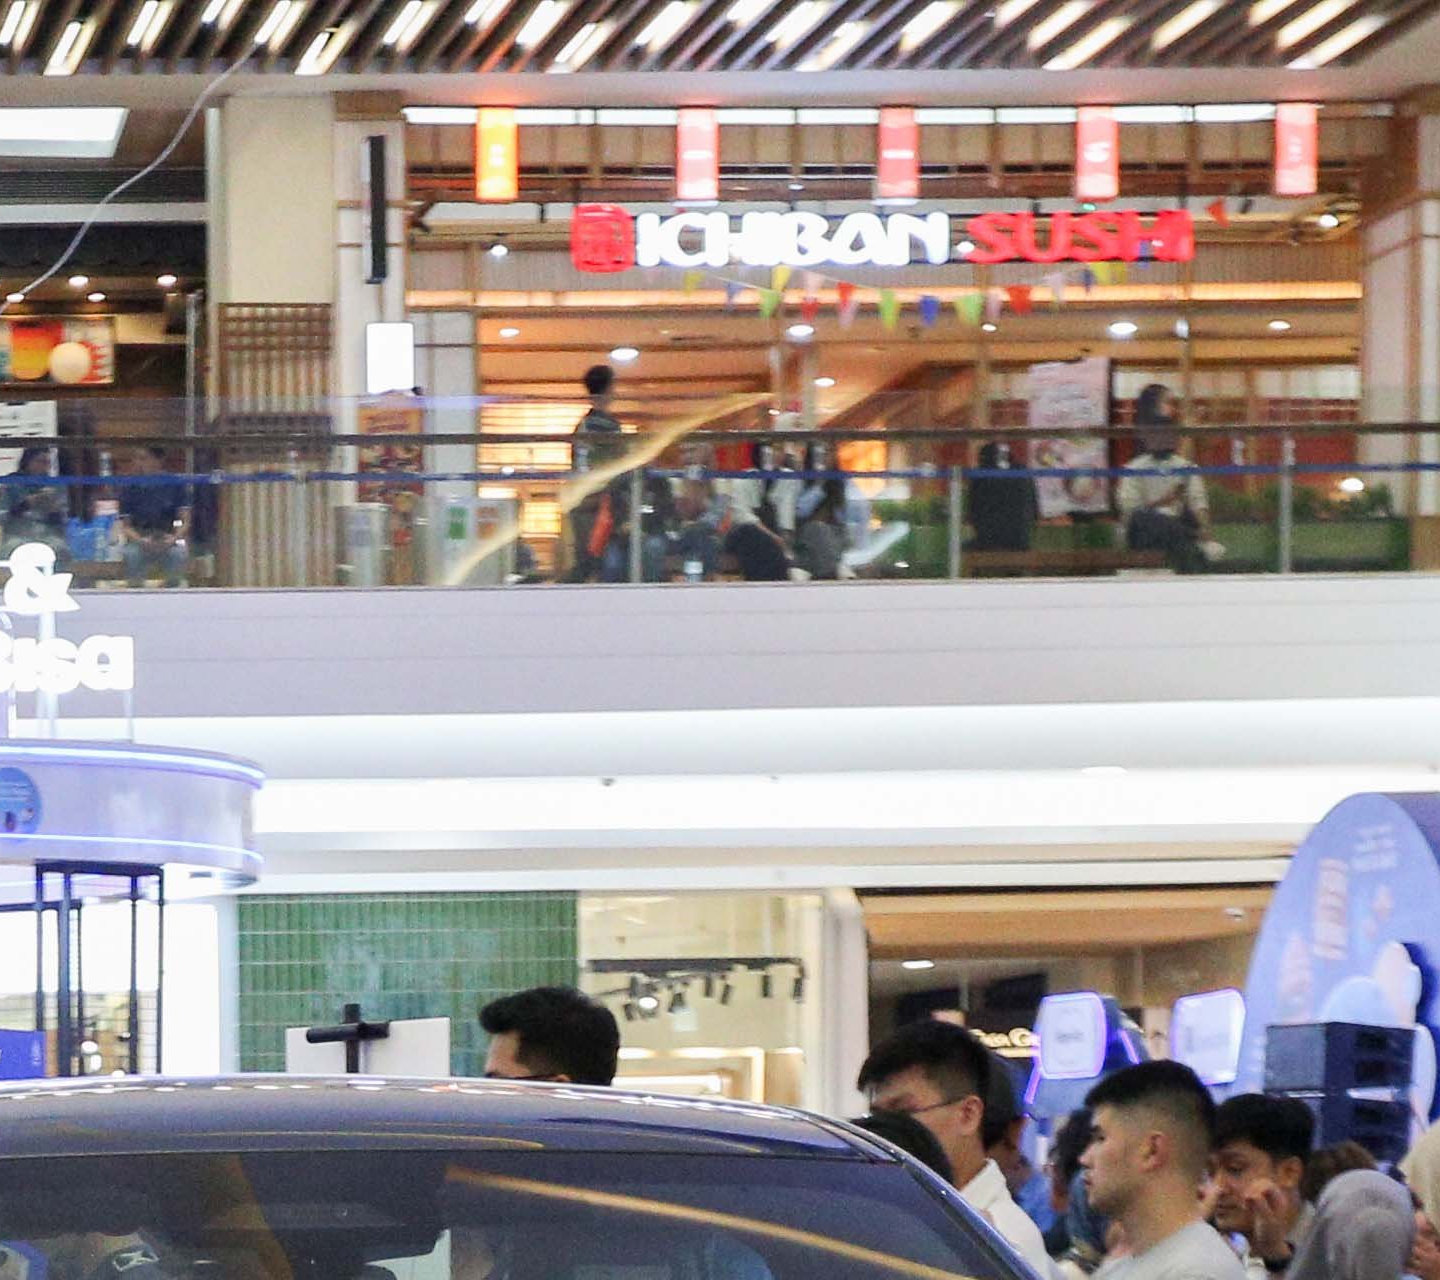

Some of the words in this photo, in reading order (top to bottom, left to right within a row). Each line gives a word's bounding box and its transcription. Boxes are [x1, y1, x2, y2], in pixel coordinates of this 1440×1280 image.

[635, 210, 951, 266] ICHIBAN
[966, 210, 1195, 263] SUSHI
[2, 542, 80, 612] &
